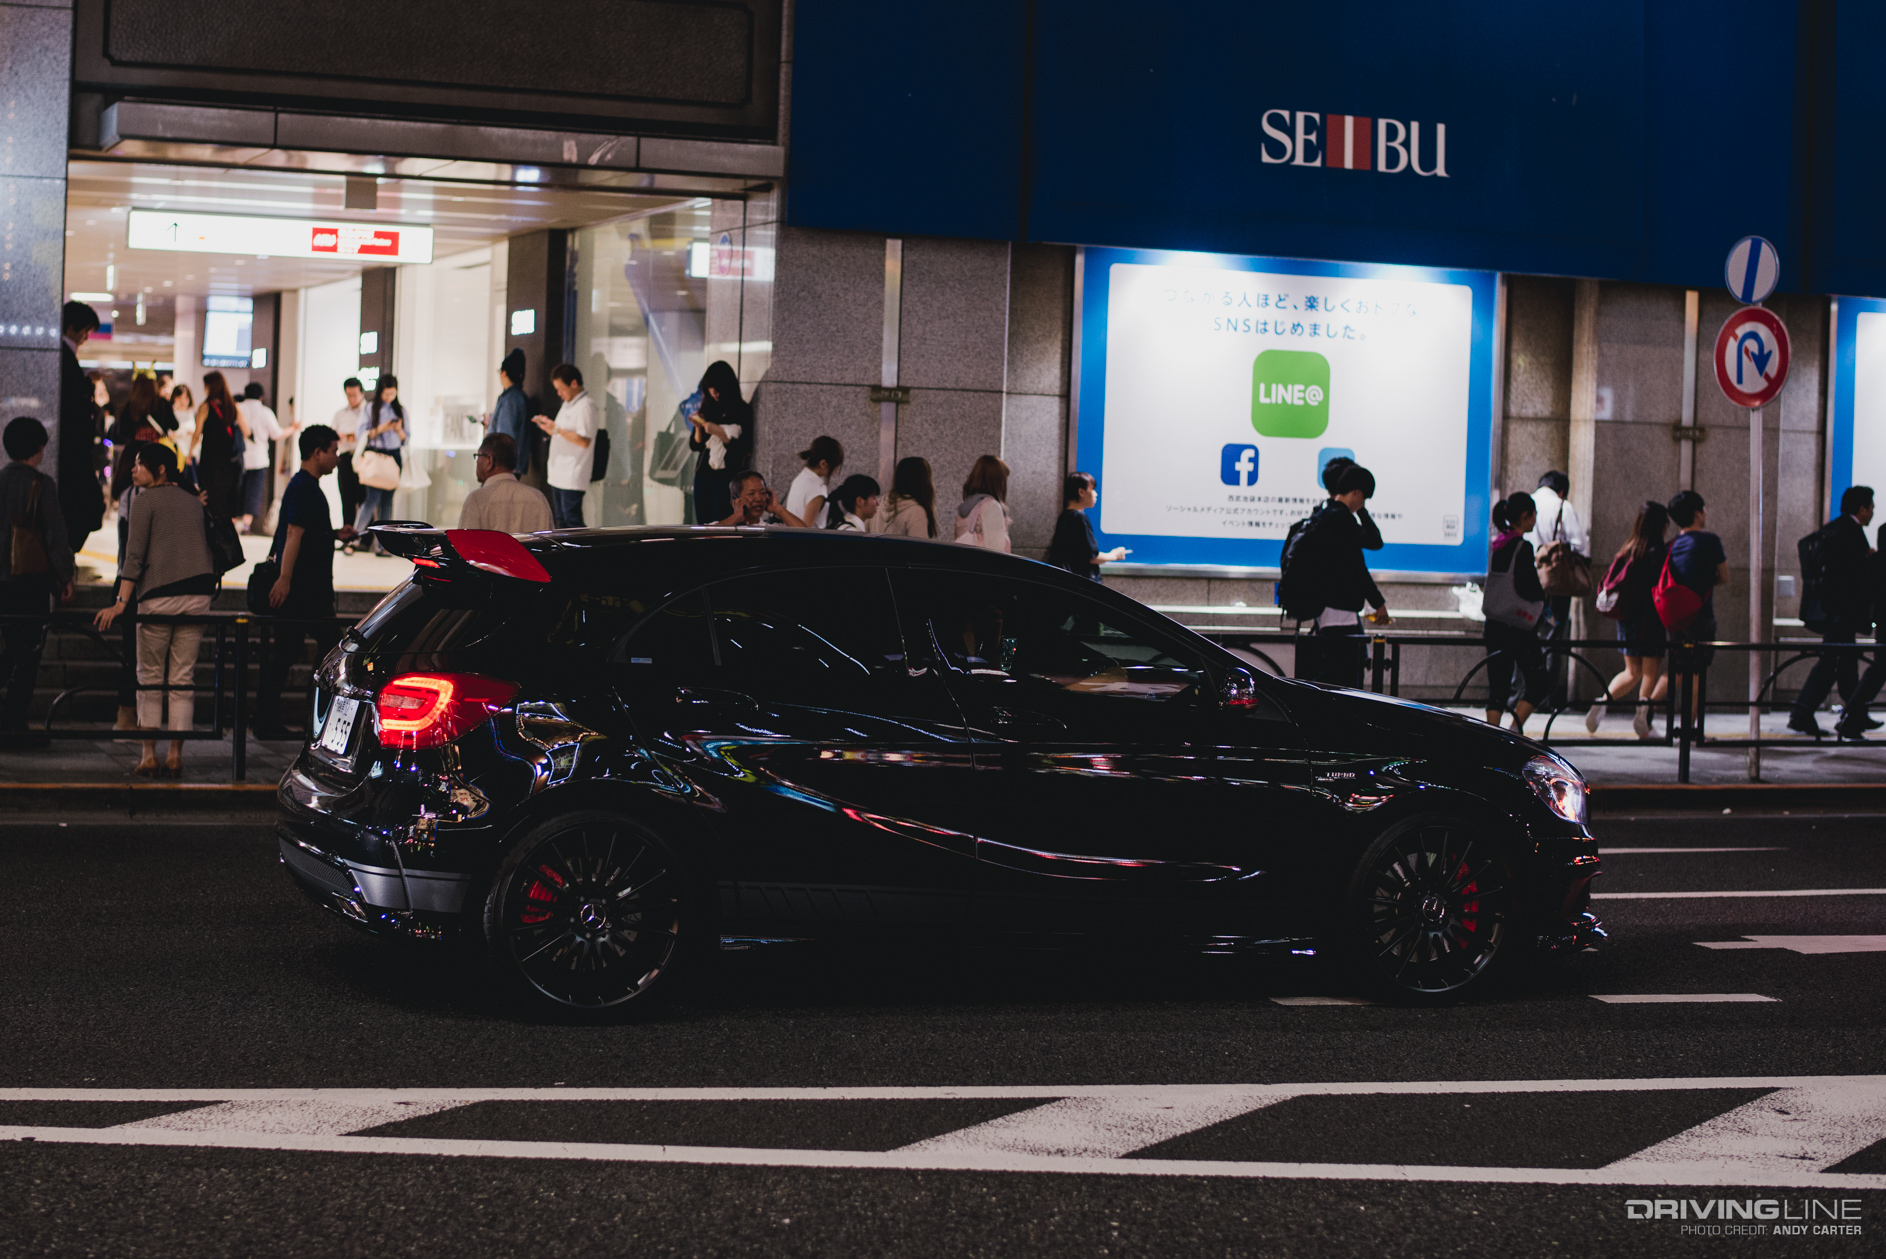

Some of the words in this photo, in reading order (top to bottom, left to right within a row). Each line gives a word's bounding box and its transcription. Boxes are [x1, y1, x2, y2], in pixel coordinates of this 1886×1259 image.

[1261, 109, 1450, 178] SEIBU
[1213, 316, 1366, 341] SNSはじめました。
[1259, 382, 1324, 406] LINE@
